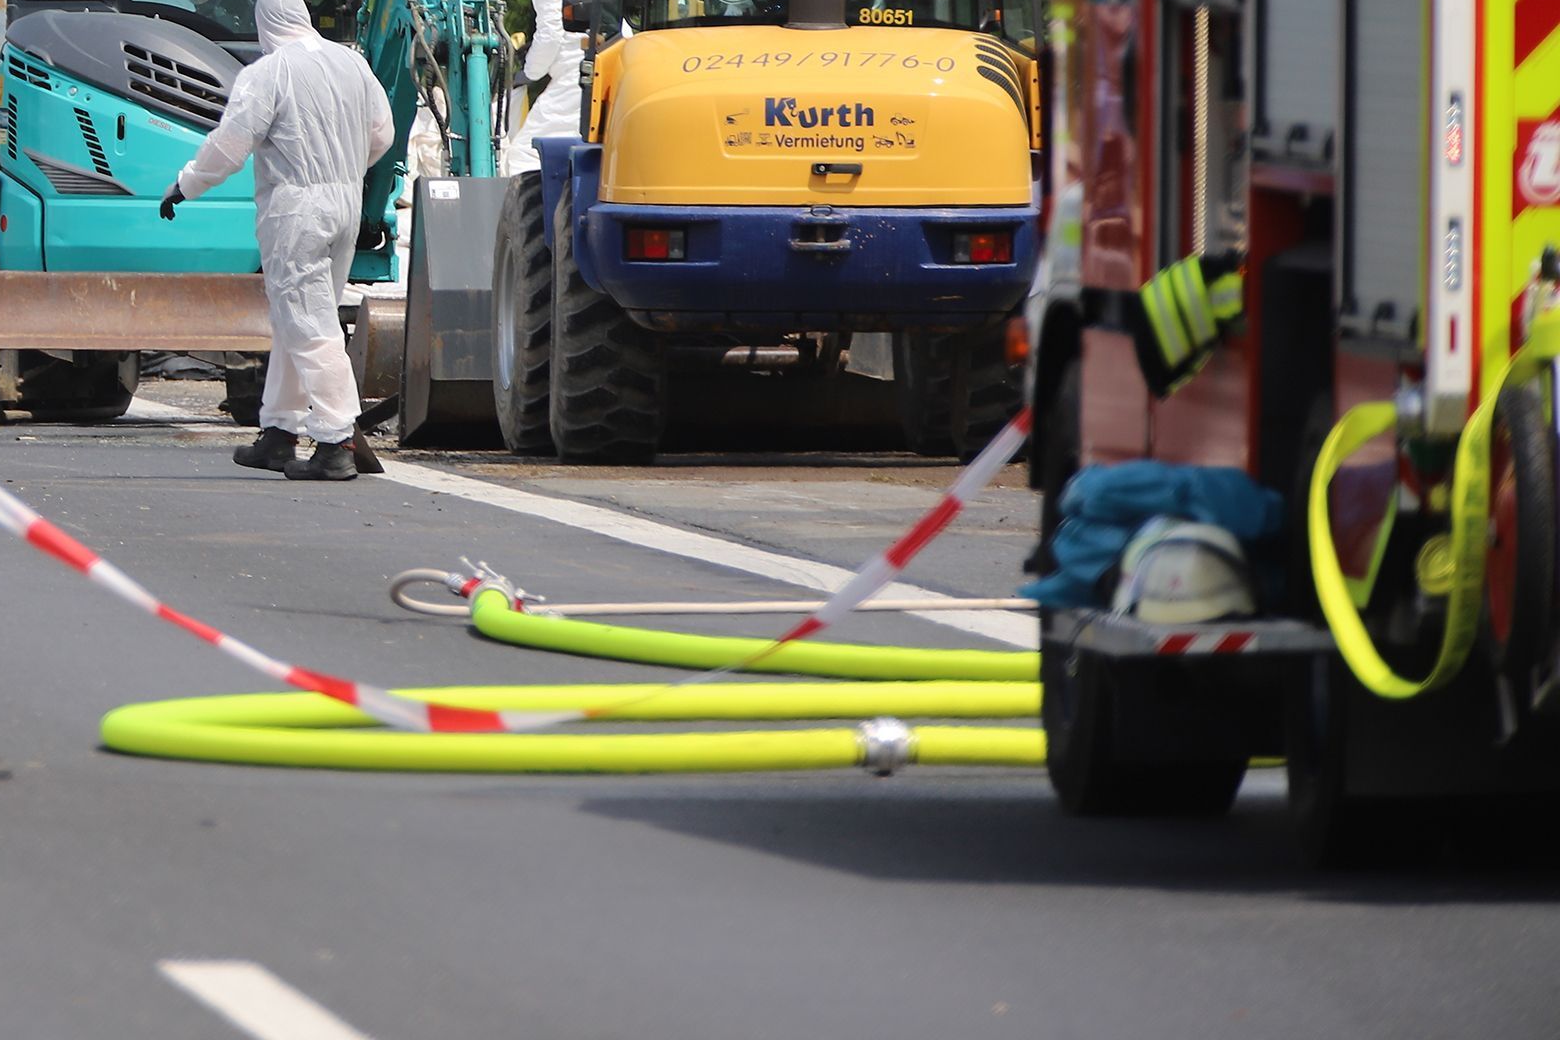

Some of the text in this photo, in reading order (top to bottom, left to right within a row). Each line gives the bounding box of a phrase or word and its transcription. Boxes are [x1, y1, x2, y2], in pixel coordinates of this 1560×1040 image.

[858, 8, 914, 26] 80651
[764, 97, 875, 129] Kurth
[774, 134, 866, 152] Vermietung
